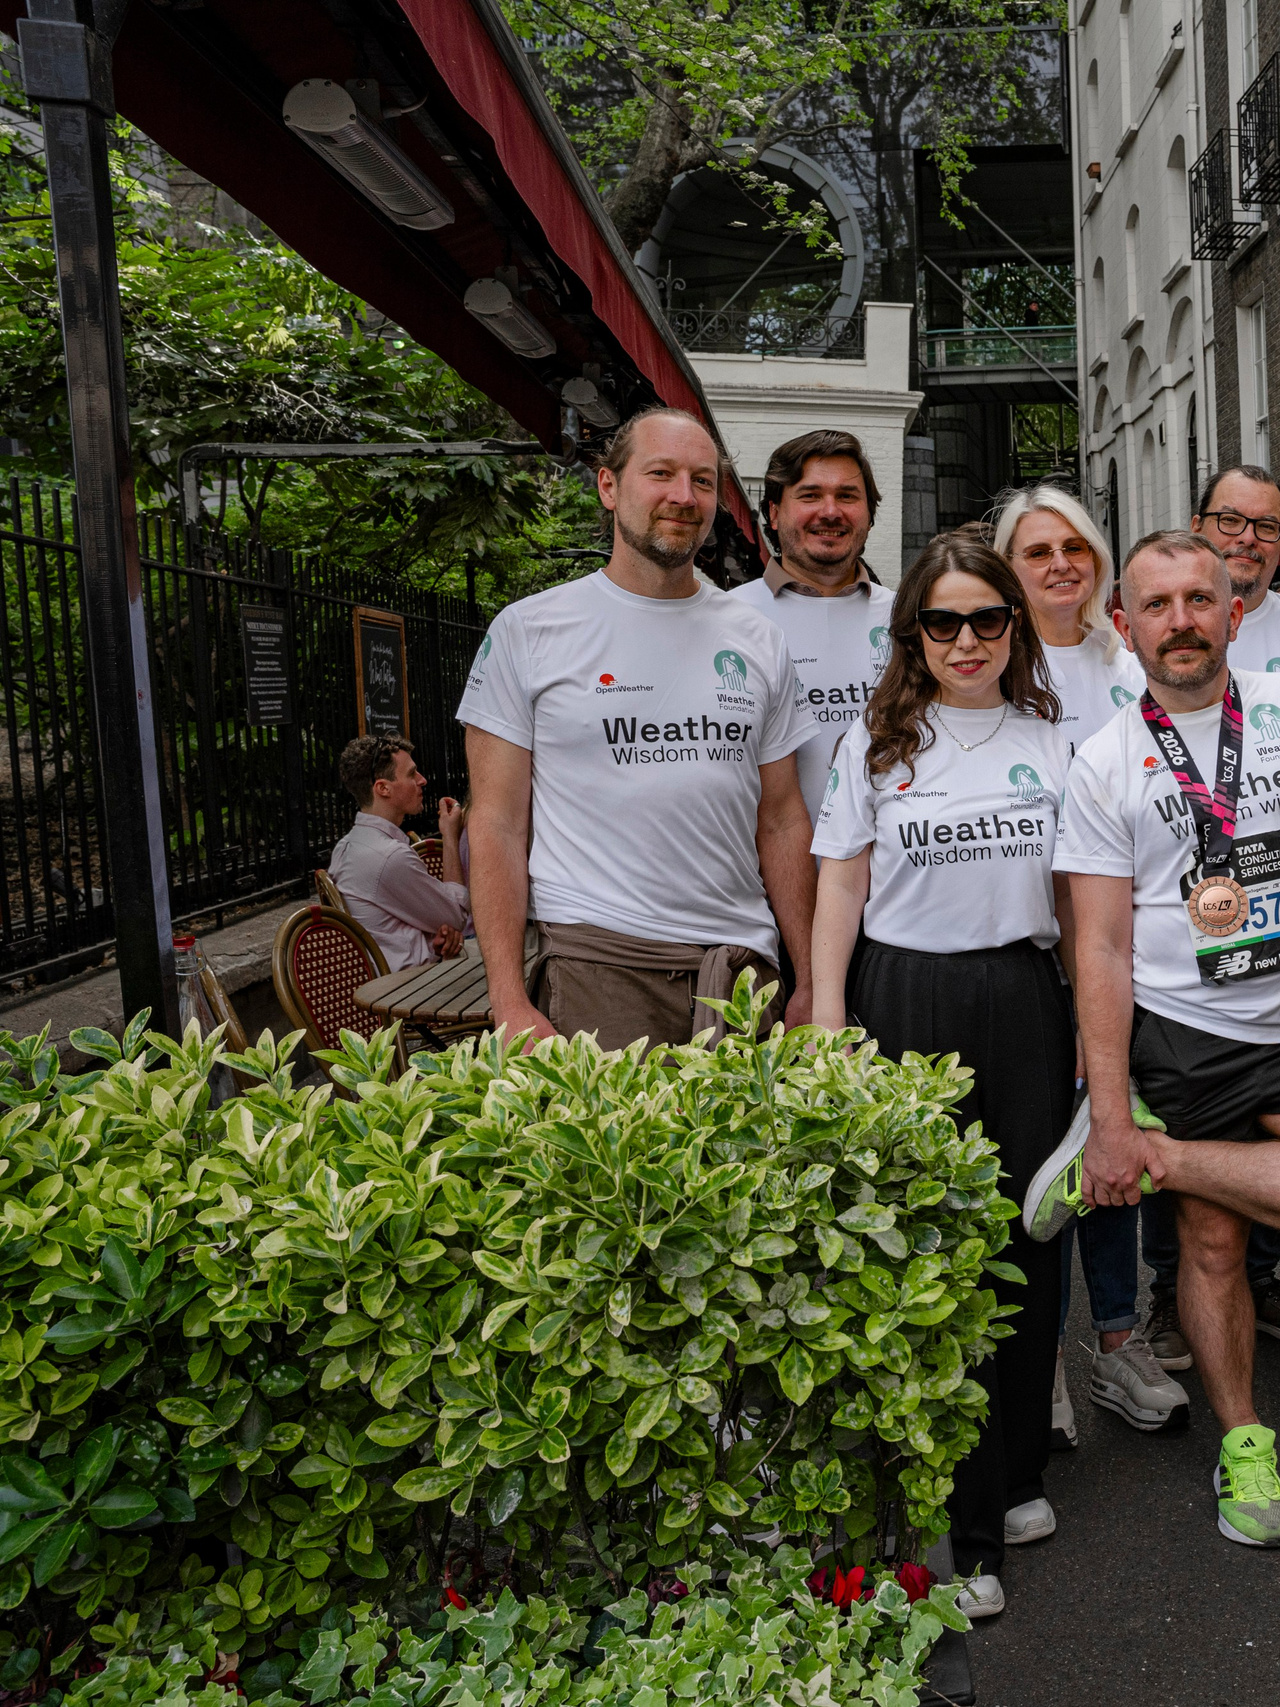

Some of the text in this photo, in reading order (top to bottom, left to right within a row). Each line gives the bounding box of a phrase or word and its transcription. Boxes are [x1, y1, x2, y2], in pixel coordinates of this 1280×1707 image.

[595, 683, 654, 695] OpenWeather
[808, 681, 878, 705] eath
[717, 693, 756, 708] Weather
[719, 703, 756, 715] Foundation
[813, 707, 860, 722] dom
[602, 715, 752, 744] Weather
[612, 744, 744, 765] Wisdom wins
[1157, 730, 1188, 766] 2026
[893, 790, 948, 801] OpenWeather
[898, 814, 1045, 849] Weather
[907, 840, 1044, 867] Wisdom wins
[1235, 842, 1266, 856] TATA
[1203, 901, 1217, 911] tcs
[1254, 956, 1278, 970] new
